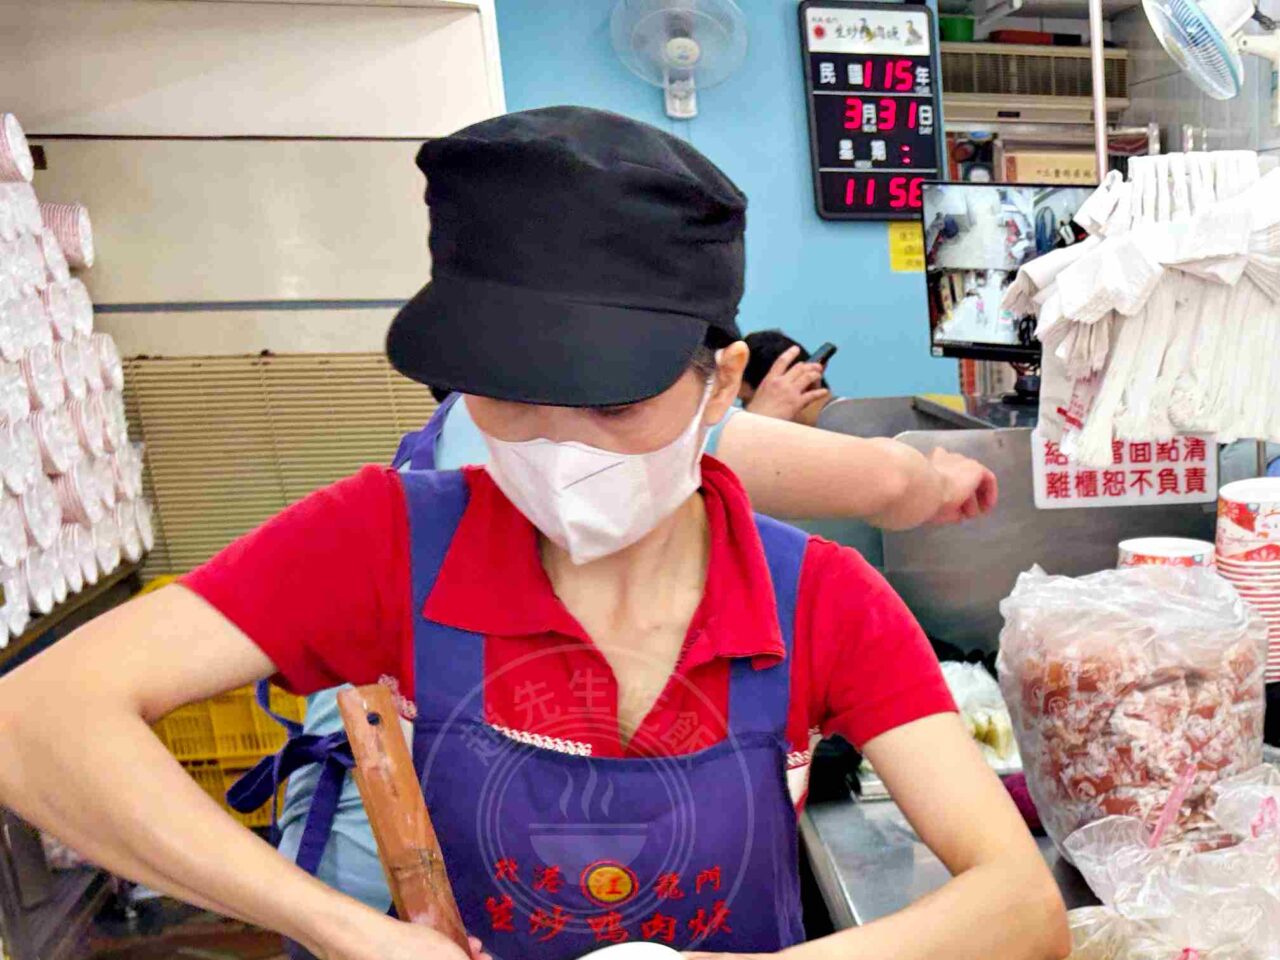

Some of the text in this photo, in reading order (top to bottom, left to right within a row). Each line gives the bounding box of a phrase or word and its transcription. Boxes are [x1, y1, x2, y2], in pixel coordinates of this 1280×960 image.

[1044, 436, 1207, 467] 結當面點清
[1045, 467, 1208, 499] 離櫃恕不負責
